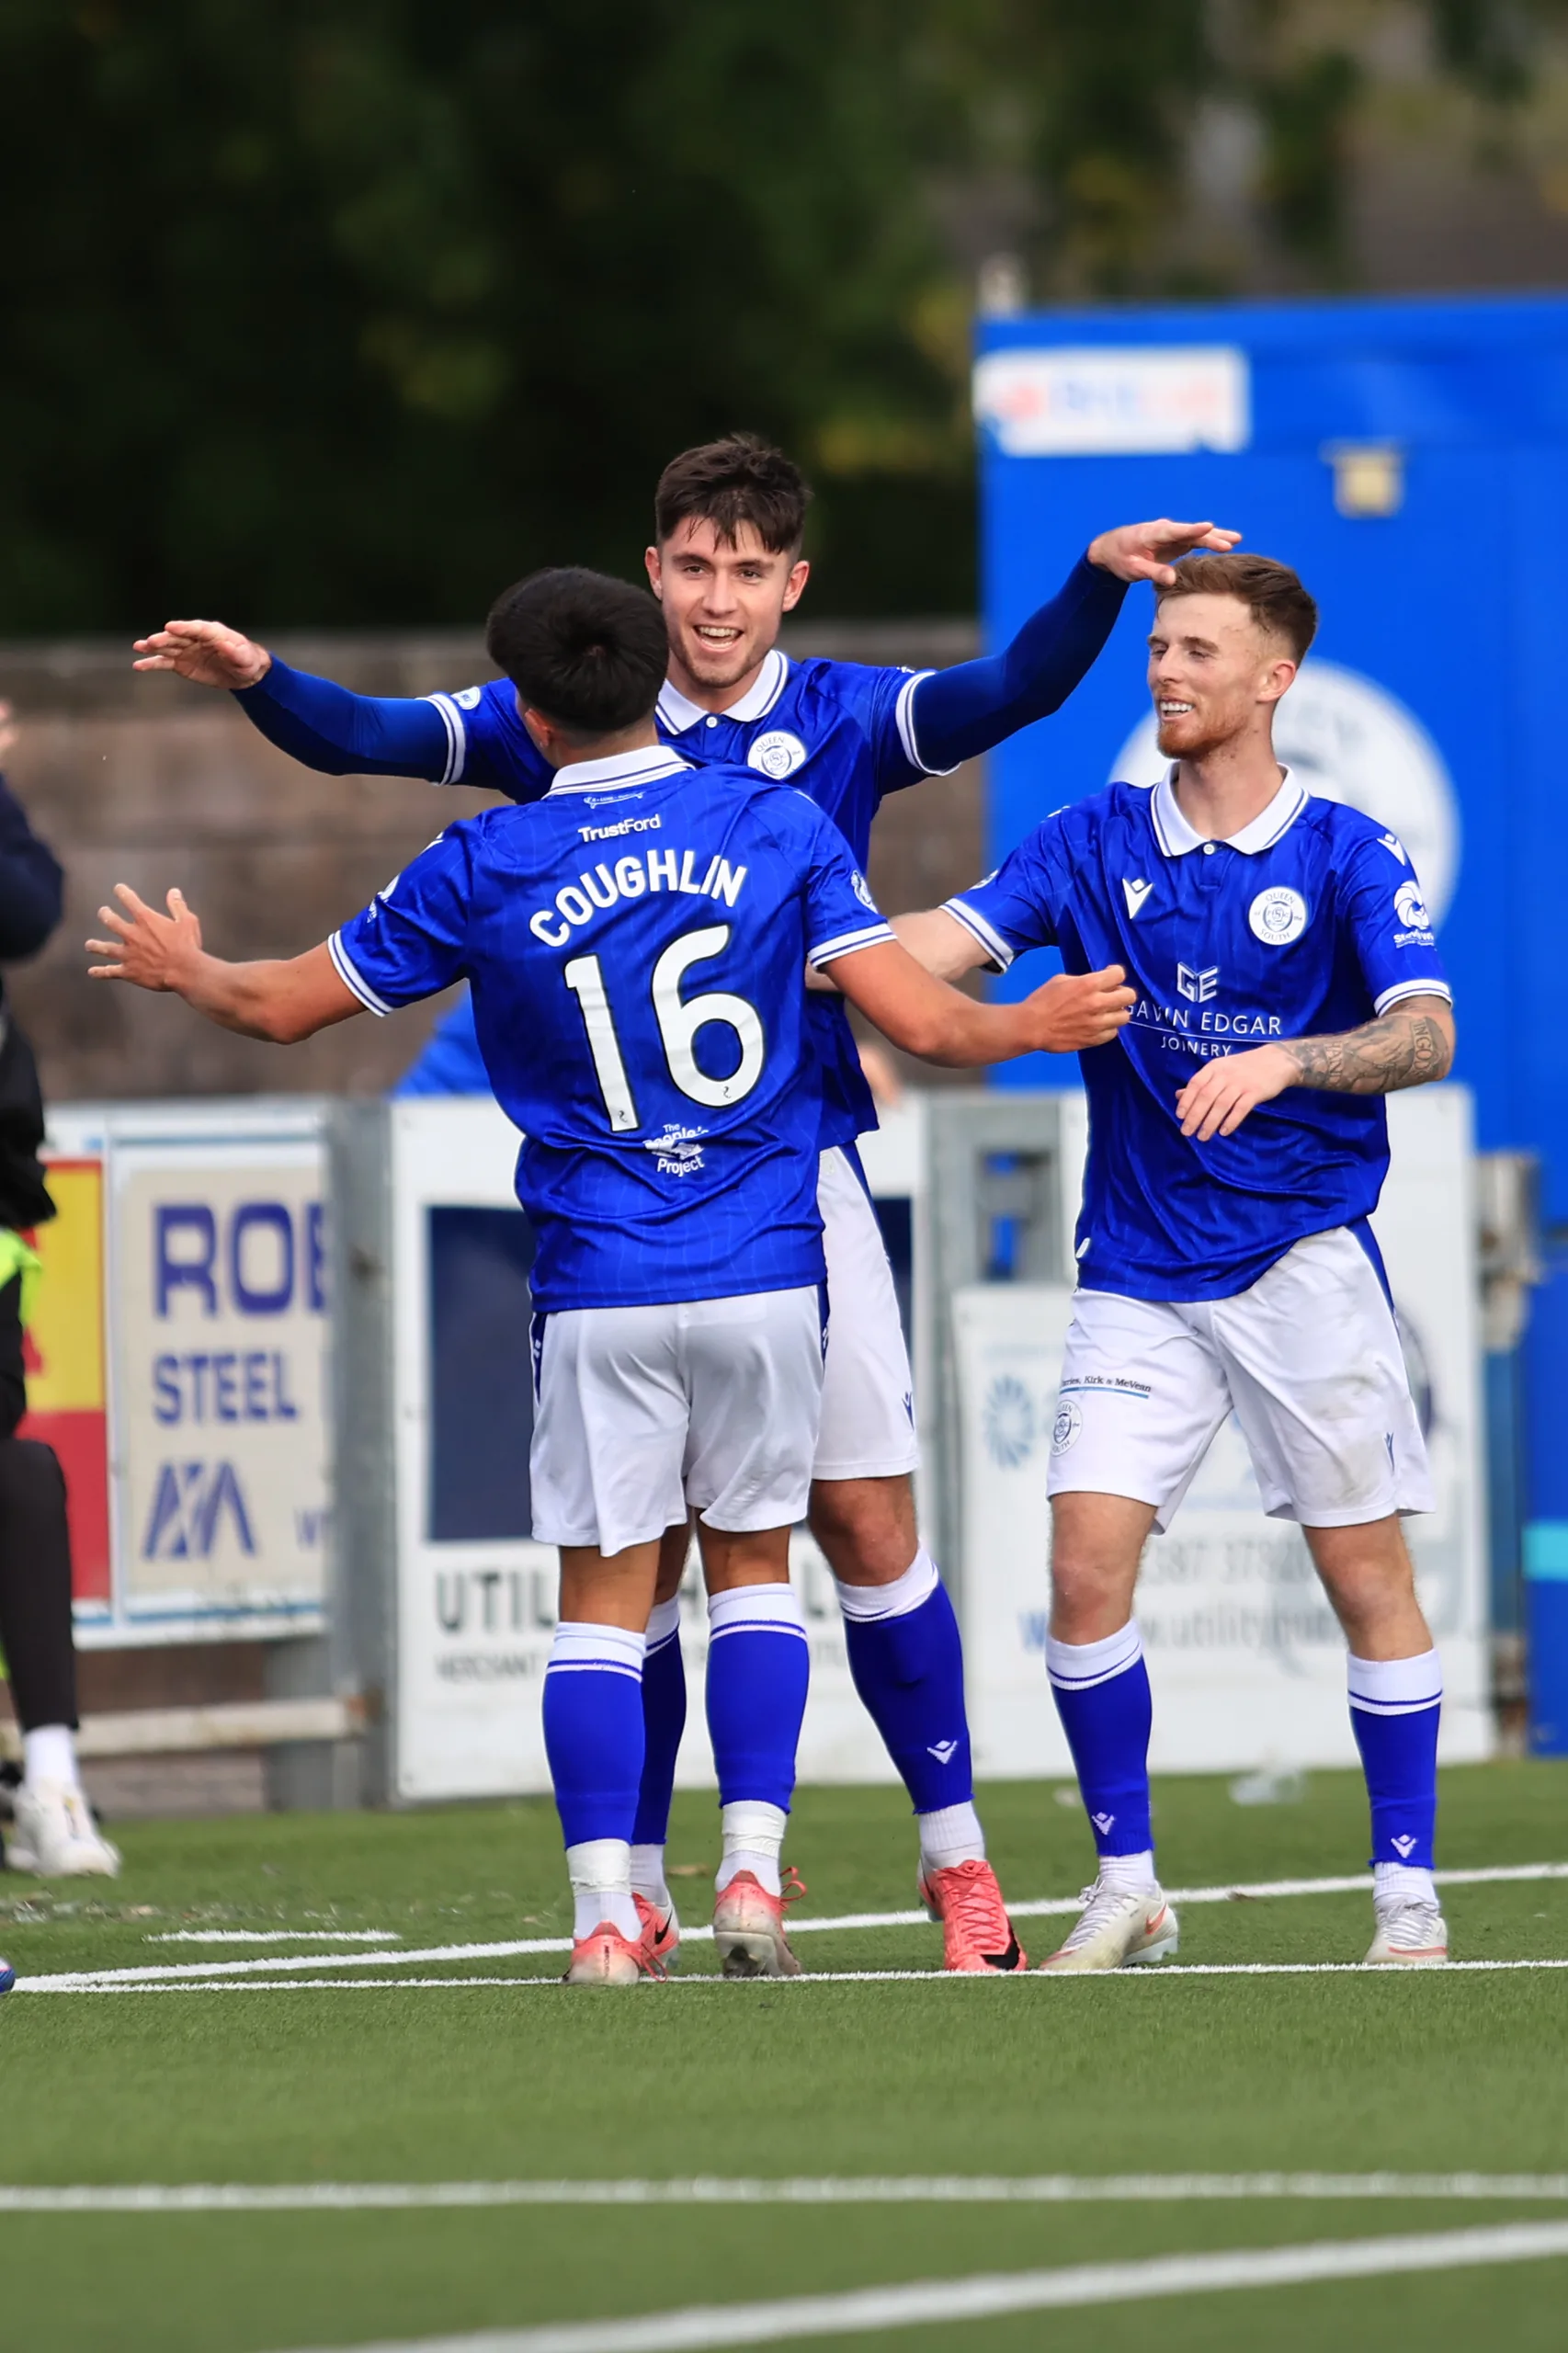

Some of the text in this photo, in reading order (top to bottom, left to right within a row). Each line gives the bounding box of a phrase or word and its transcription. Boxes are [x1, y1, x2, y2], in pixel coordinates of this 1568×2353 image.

[578, 813, 662, 843] TrustFord
[528, 849, 747, 948] COUGHLIN
[1266, 892, 1295, 904] QUEEN
[1177, 961, 1219, 1003] GE
[563, 924, 766, 1132] 16
[1200, 1011, 1282, 1035] EDGAR
[1160, 1036, 1232, 1057] JOINERY
[663, 1123, 680, 1133] The
[656, 1155, 705, 1177] Project
[153, 1350, 299, 1425] STEEL
[1084, 1375, 1104, 1385] Kirk
[1115, 1378, 1152, 1392] McVean
[436, 1568, 557, 1634] UTIL
